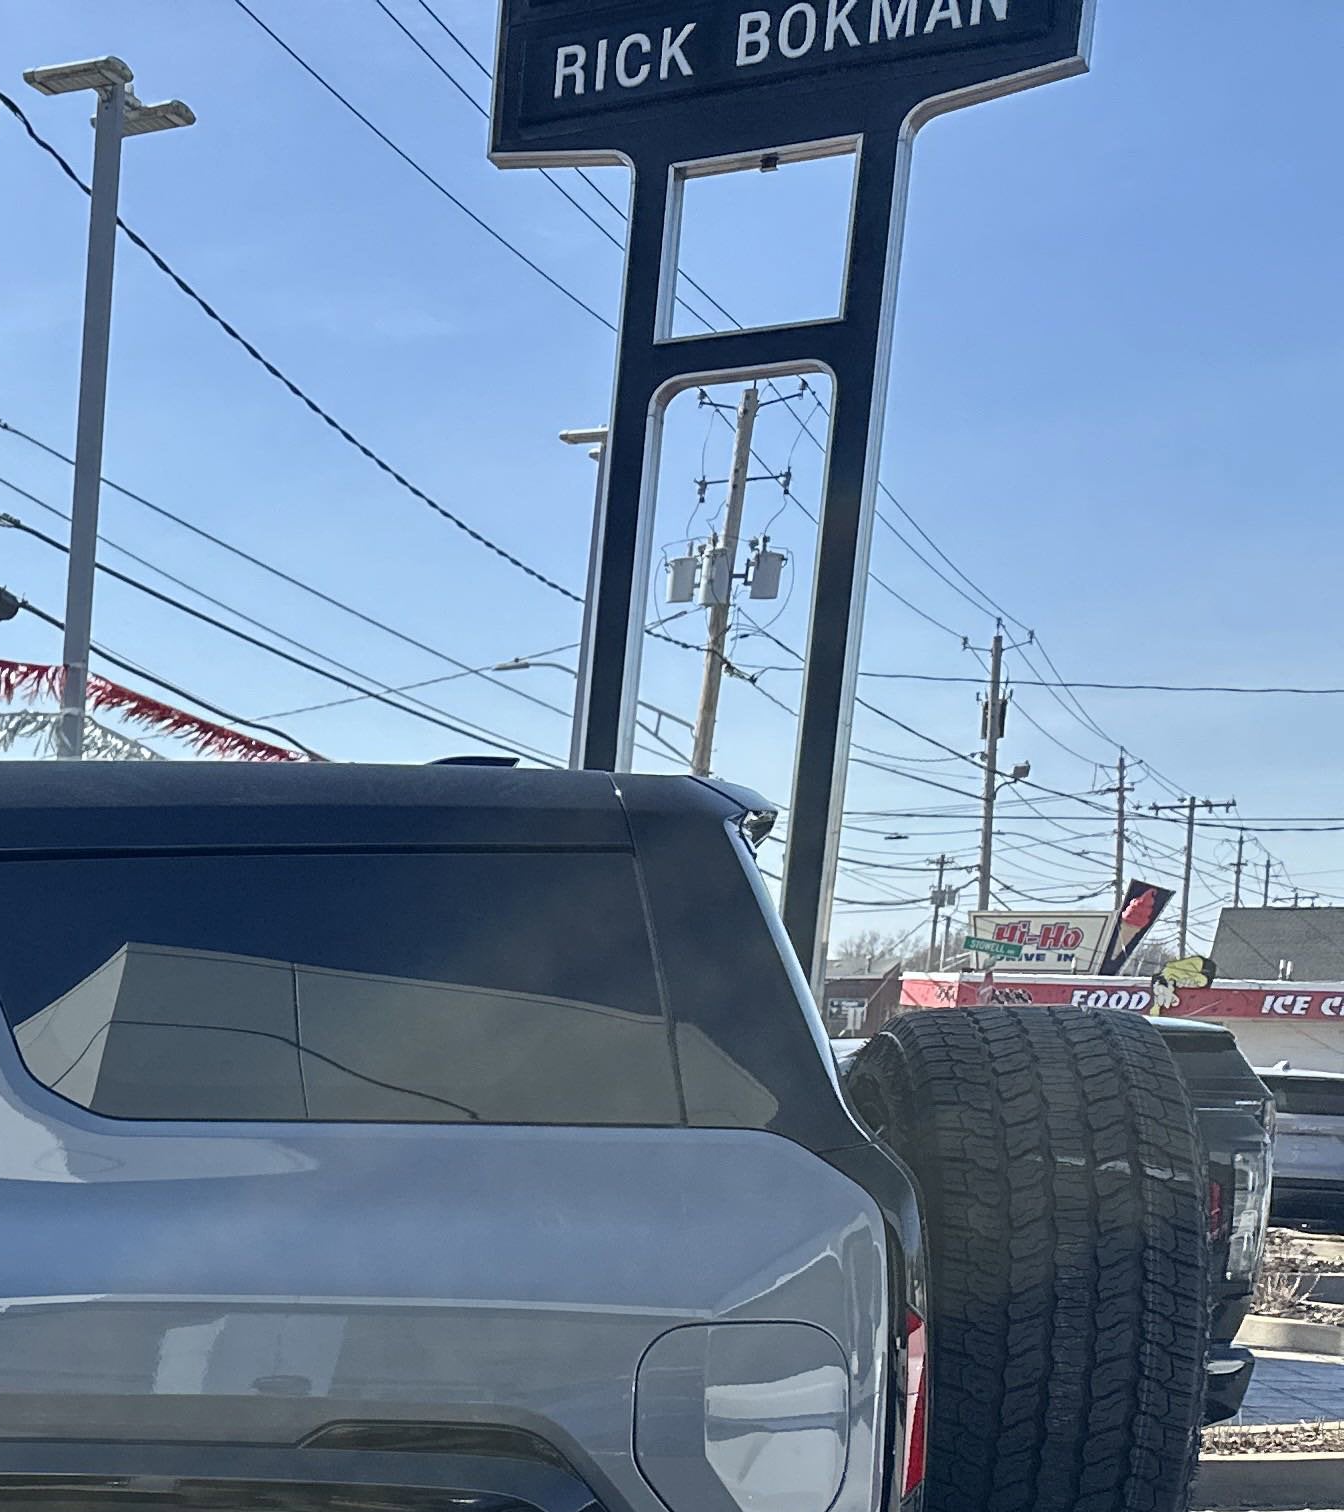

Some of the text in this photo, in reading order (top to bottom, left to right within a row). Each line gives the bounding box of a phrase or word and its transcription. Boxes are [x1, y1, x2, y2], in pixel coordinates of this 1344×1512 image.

[554, 22, 697, 98] RICK
[993, 921, 1084, 950] Hi-Ho
[1070, 989, 1344, 1016] FOOD ICE C
